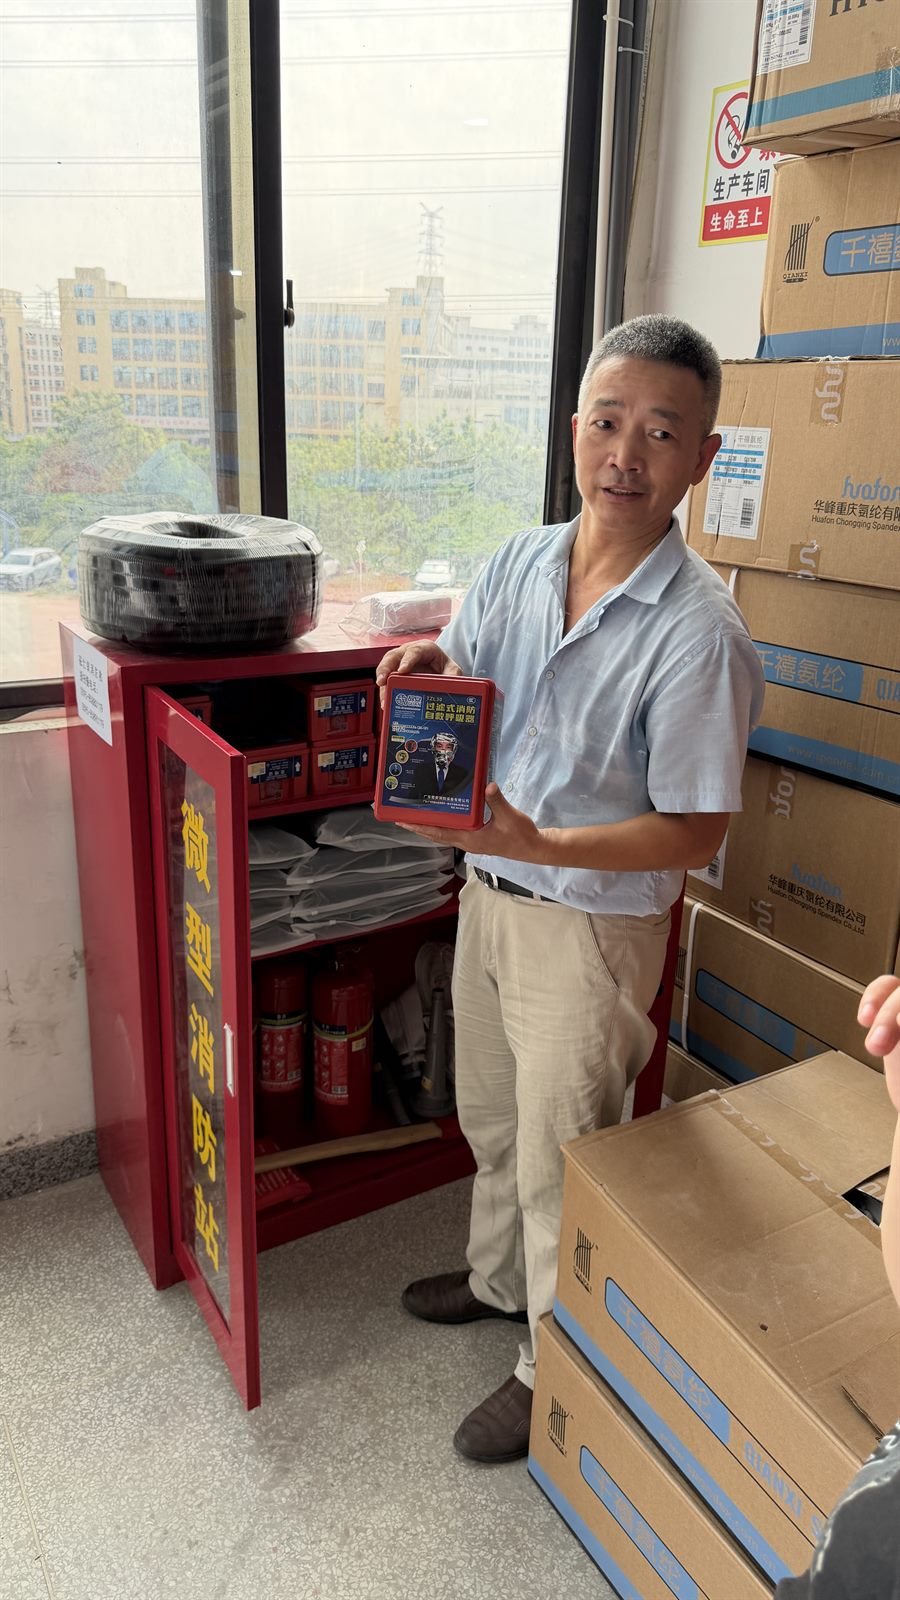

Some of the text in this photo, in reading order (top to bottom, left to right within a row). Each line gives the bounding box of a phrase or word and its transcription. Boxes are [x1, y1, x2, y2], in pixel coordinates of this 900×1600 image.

[713, 168, 770, 201] 生产车间
[709, 206, 763, 232] 生命至上
[811, 514, 835, 524] Huafon
[836, 517, 871, 530] Chongqing
[424, 711, 475, 724] 自救呼吸器
[425, 702, 476, 716] 过滤式消防
[768, 873, 866, 928] 华峰重庆氨纶有限公司
[181, 799, 219, 1273] 微型消防站
[743, 1440, 804, 1519] QIANXI
